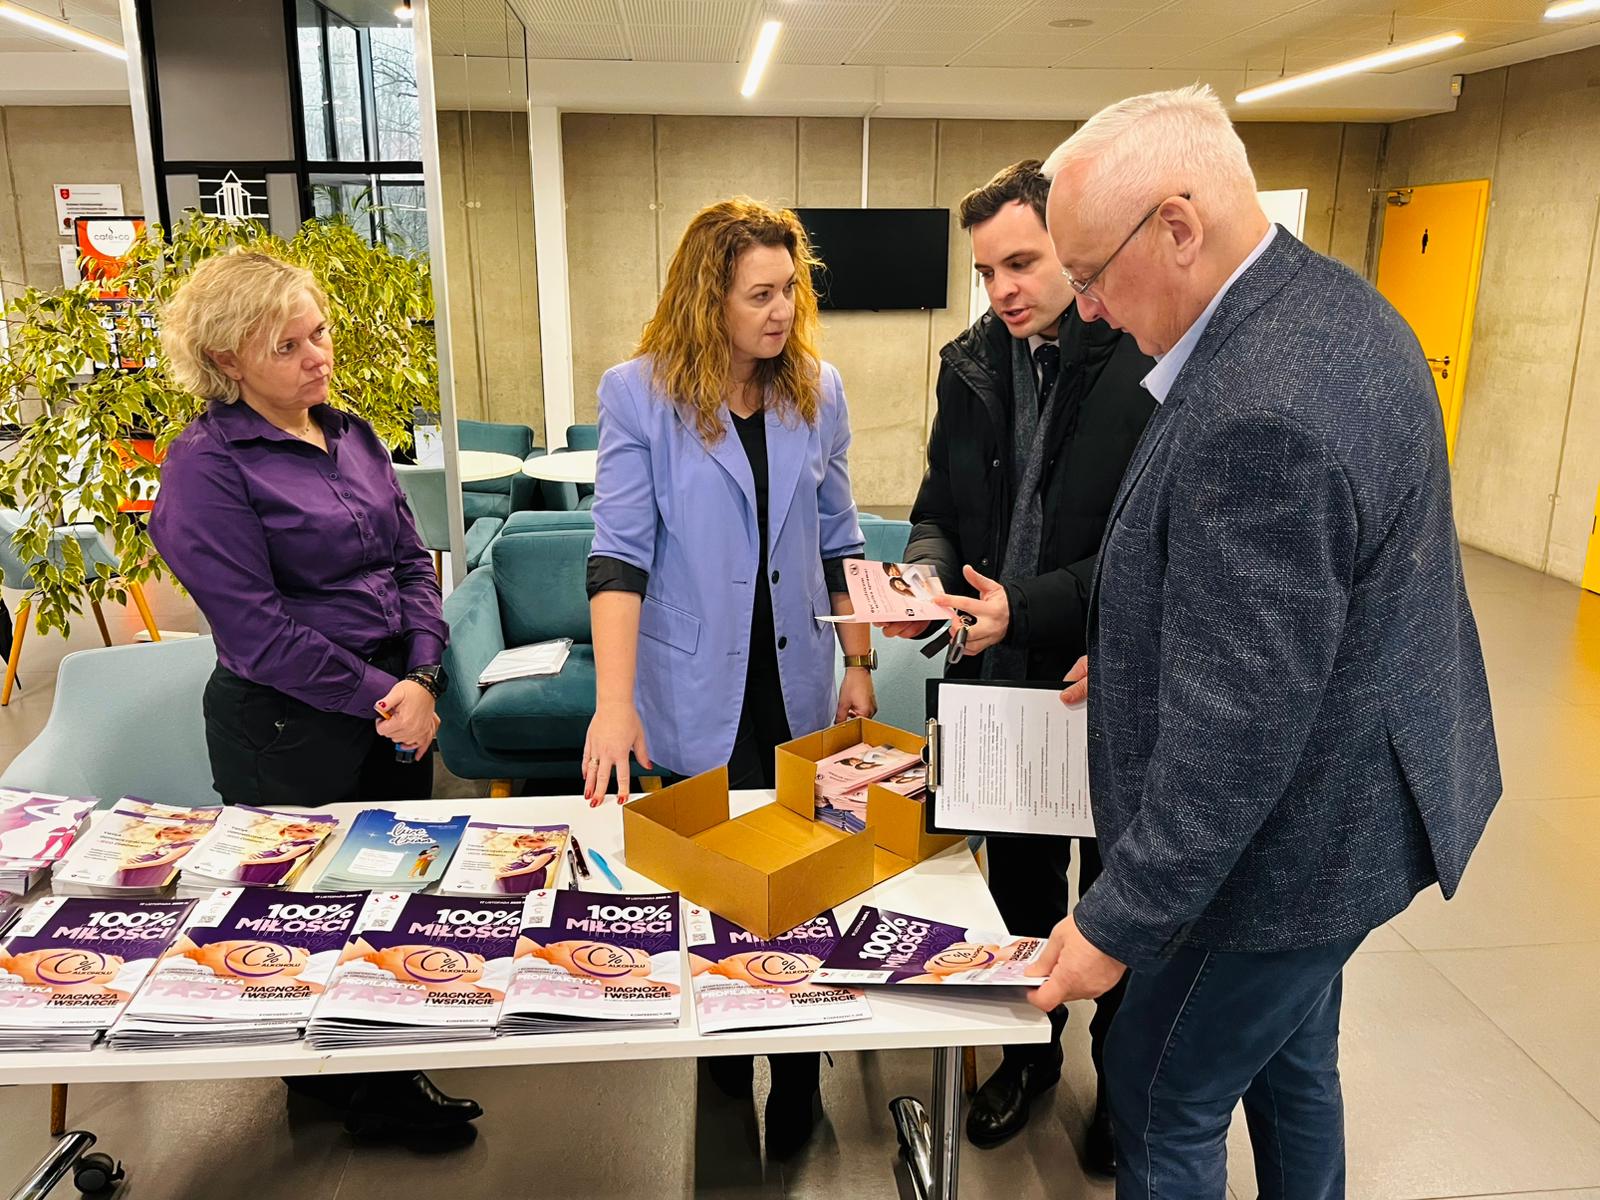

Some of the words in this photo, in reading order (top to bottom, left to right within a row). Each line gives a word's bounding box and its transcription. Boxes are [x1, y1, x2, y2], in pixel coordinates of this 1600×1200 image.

[267, 903, 356, 920] 100%
[436, 908, 522, 926] 100%
[587, 904, 672, 922] 100%
[88, 911, 180, 927] 100%
[858, 915, 908, 959] 100%
[338, 978, 428, 991] PROFILAKTYKA
[515, 973, 602, 986] PROFILAKTYKA
[604, 985, 668, 993] DIAGNOZA
[608, 991, 672, 1000] WSPARCIE
[789, 988, 851, 999] DIAGNOZA
[432, 998, 495, 1006] WSPARCIE
[798, 994, 857, 1004] WSPARCIE
